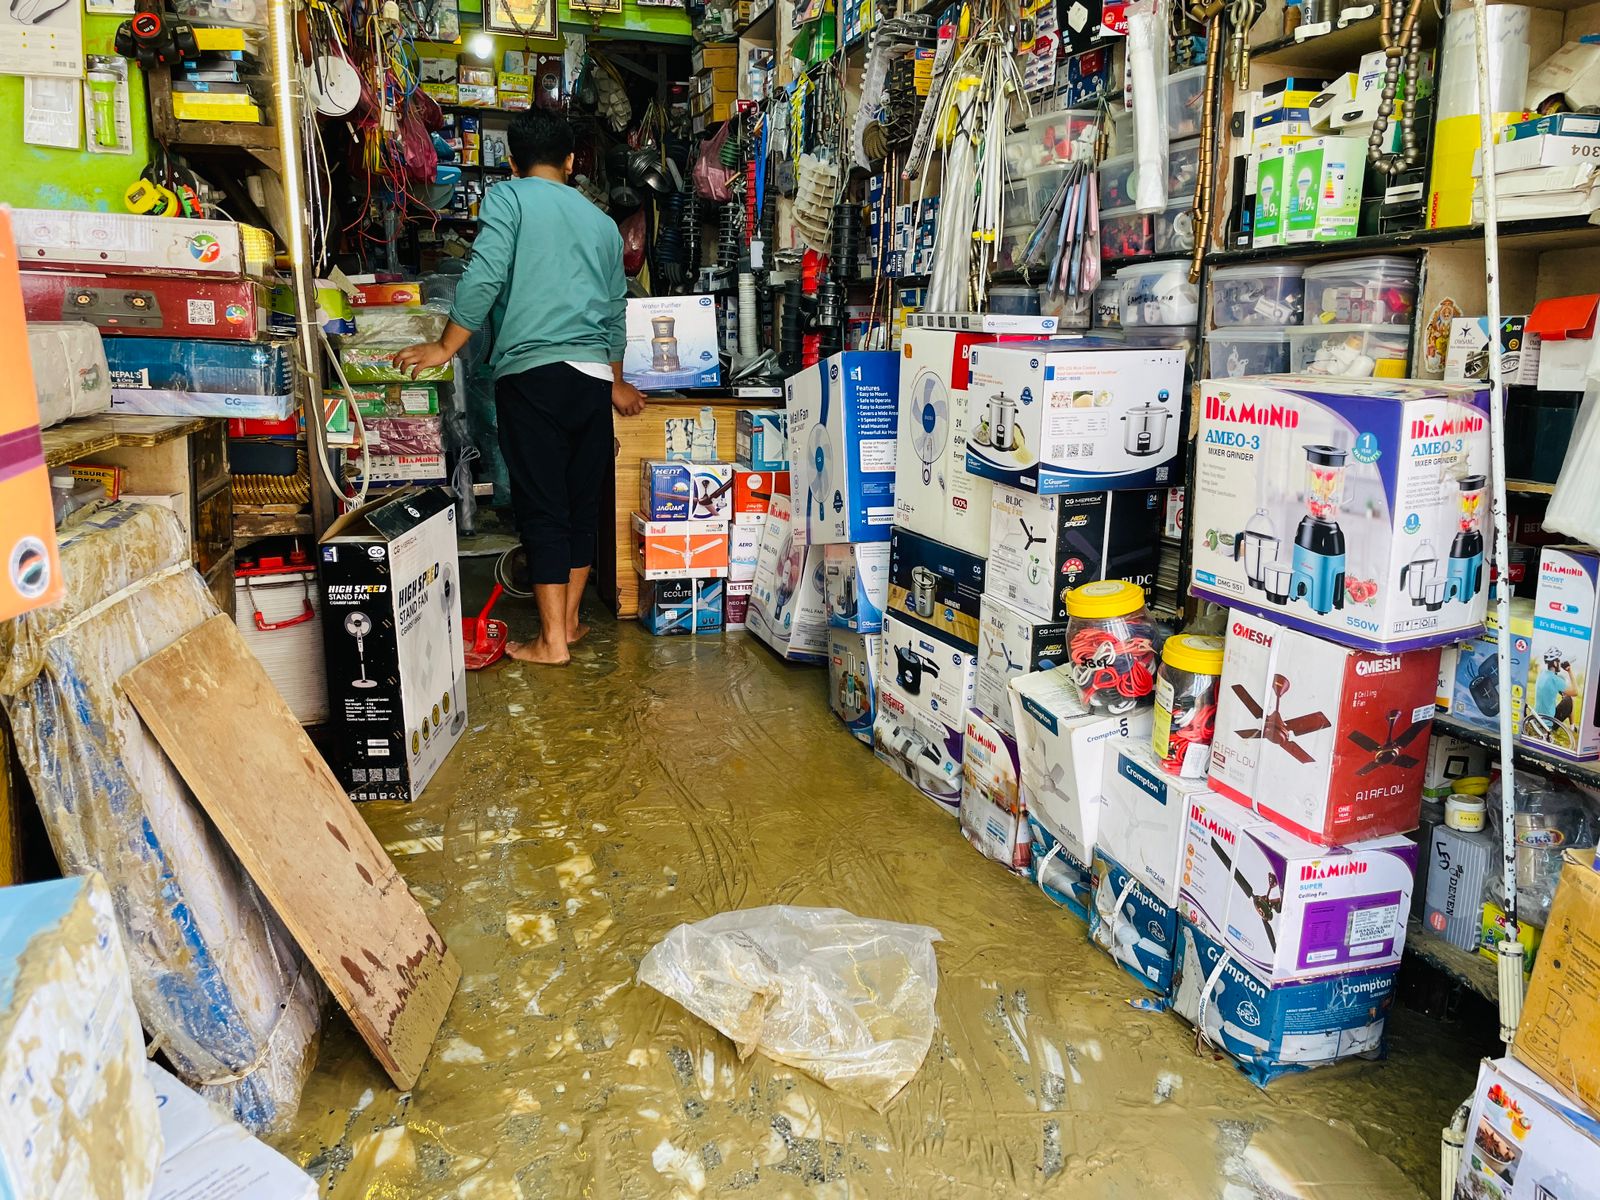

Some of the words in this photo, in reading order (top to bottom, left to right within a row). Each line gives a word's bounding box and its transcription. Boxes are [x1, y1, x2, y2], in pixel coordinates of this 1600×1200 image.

[110, 371, 142, 379] NEPAL'S
[139, 367, 153, 389] 1
[224, 397, 242, 406] CG
[1206, 397, 1299, 429] DIAMOND
[1411, 416, 1483, 440] DIAMOND
[1205, 429, 1260, 451] AMEO-3
[1362, 434, 1370, 449] 1
[1208, 447, 1226, 458] MIXER
[1226, 449, 1254, 461] GRINDER
[1353, 447, 1382, 463] WARRANTY
[1411, 439, 1463, 457] AMEO-3
[398, 456, 439, 464] DIAMOND
[1414, 459, 1433, 467] MIXER
[1433, 456, 1458, 466] GRINDER
[953, 497, 968, 509] 100%
[1005, 494, 1024, 508] BLDC
[370, 548, 383, 556] CG
[973, 565, 981, 575] CG
[1542, 562, 1583, 577] DIAMOND
[398, 578, 418, 609] HIGH
[417, 562, 439, 590] SPEED
[1121, 573, 1153, 586] BLDC
[1217, 577, 1231, 588] DMG
[328, 585, 353, 594] HIGH
[354, 584, 388, 593] SPEED
[663, 590, 692, 598] ECOLITE
[328, 593, 353, 601] STAND
[399, 600, 418, 625] STAND
[417, 590, 429, 610] FAN
[1346, 616, 1380, 633] 550W
[1540, 620, 1550, 628] It's
[1550, 623, 1568, 632] Break
[1086, 728, 1121, 743] Crompton
[1213, 741, 1256, 769] AIRFLOW
[1125, 764, 1159, 794] Crompton
[1355, 784, 1405, 802] AIRFLOW
[1338, 805, 1351, 813] ONE
[1145, 865, 1166, 887] BRIZAIR
[1300, 861, 1368, 881] DIAMOND
[1299, 882, 1323, 891] SUPER
[1207, 946, 1266, 999] Crmpton
[1342, 977, 1392, 995] Crompton
